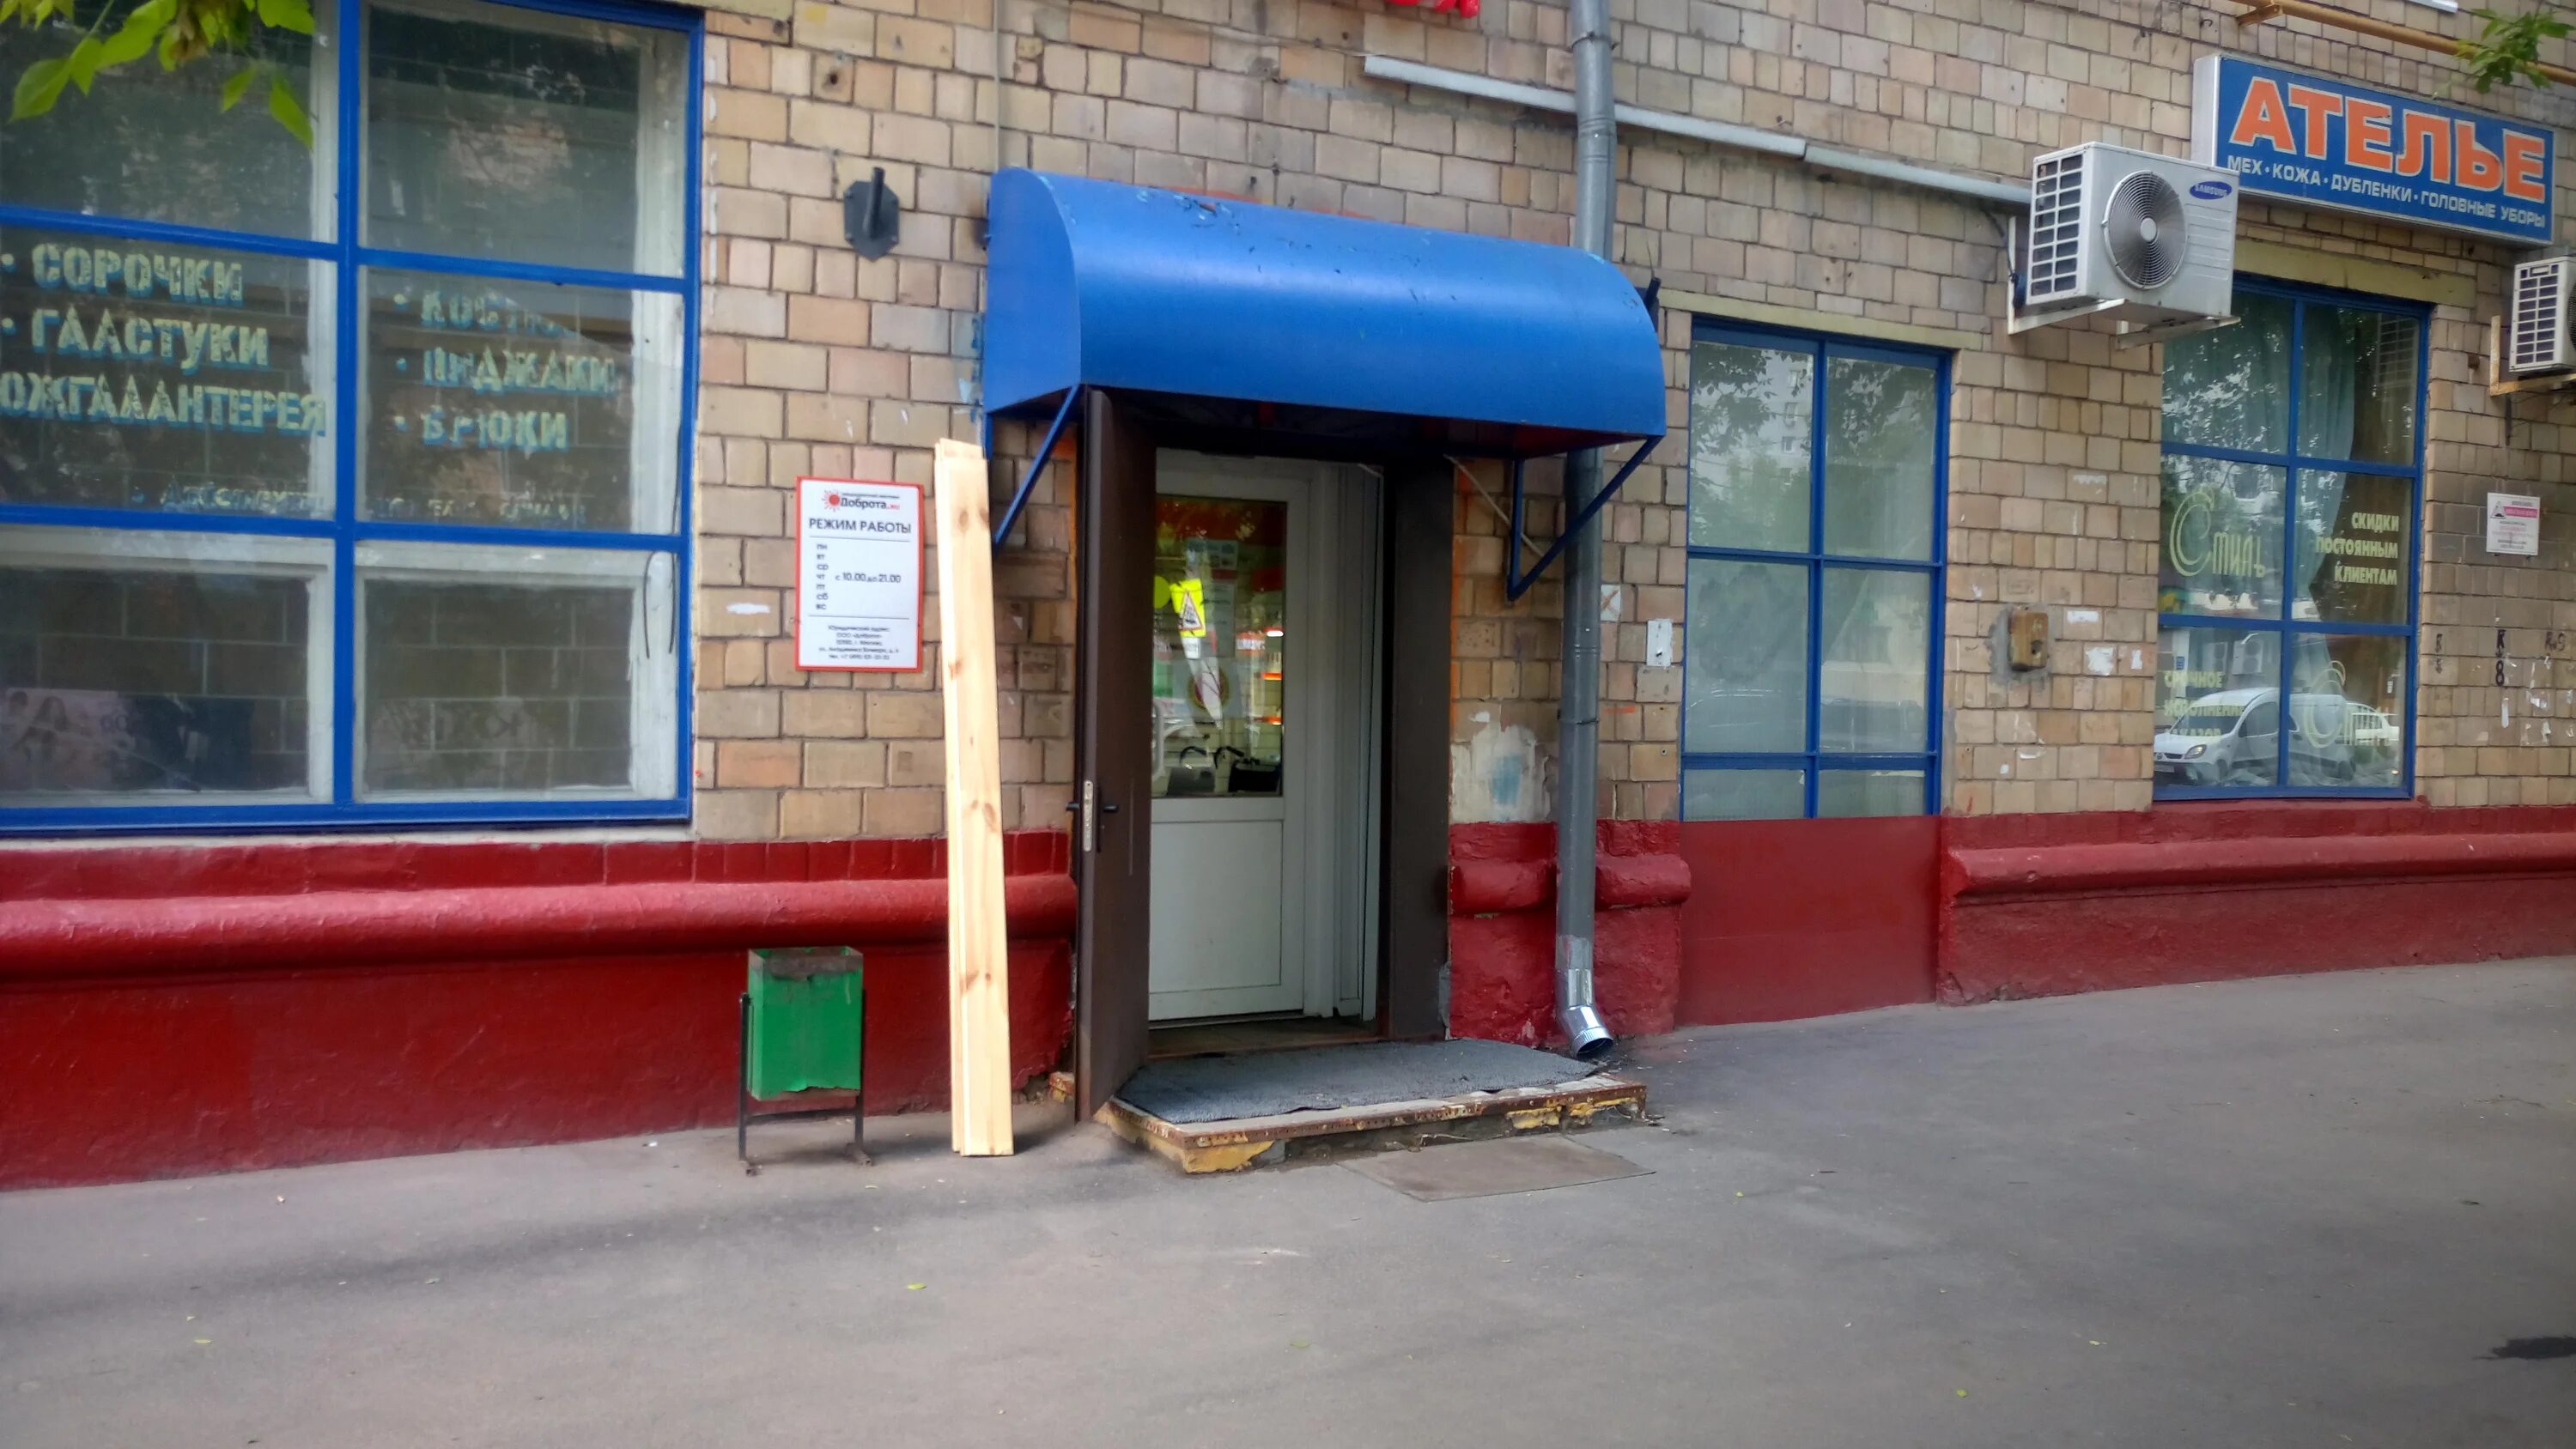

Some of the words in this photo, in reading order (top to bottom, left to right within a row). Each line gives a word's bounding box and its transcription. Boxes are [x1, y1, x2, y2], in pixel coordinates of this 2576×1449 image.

[2229, 76, 2546, 203] АТЕЛЬЕ
[2195, 185, 2227, 197] SAMSUNG
[2227, 155, 2263, 175] МЕХ
[2272, 163, 2321, 186] КОЖА
[2330, 174, 2412, 203] ДУБЛЕНКИ
[2421, 191, 2496, 218] ГОЛОВНЫЕ
[2500, 206, 2546, 227] УБОРЫ
[32, 243, 244, 306] СОРОЧКИ
[32, 303, 270, 375] ГАЛСТУКИ
[809, 518, 857, 530] РЕЖИМ
[860, 521, 912, 534] РАБОТЫ
[2351, 512, 2399, 533] СКИДКИ
[2316, 537, 2398, 559] ПОСТОЯННЫМ
[842, 572, 866, 581] 10.00
[878, 573, 902, 584] 21.00
[2335, 564, 2397, 585] КЛИЕНТАМ
